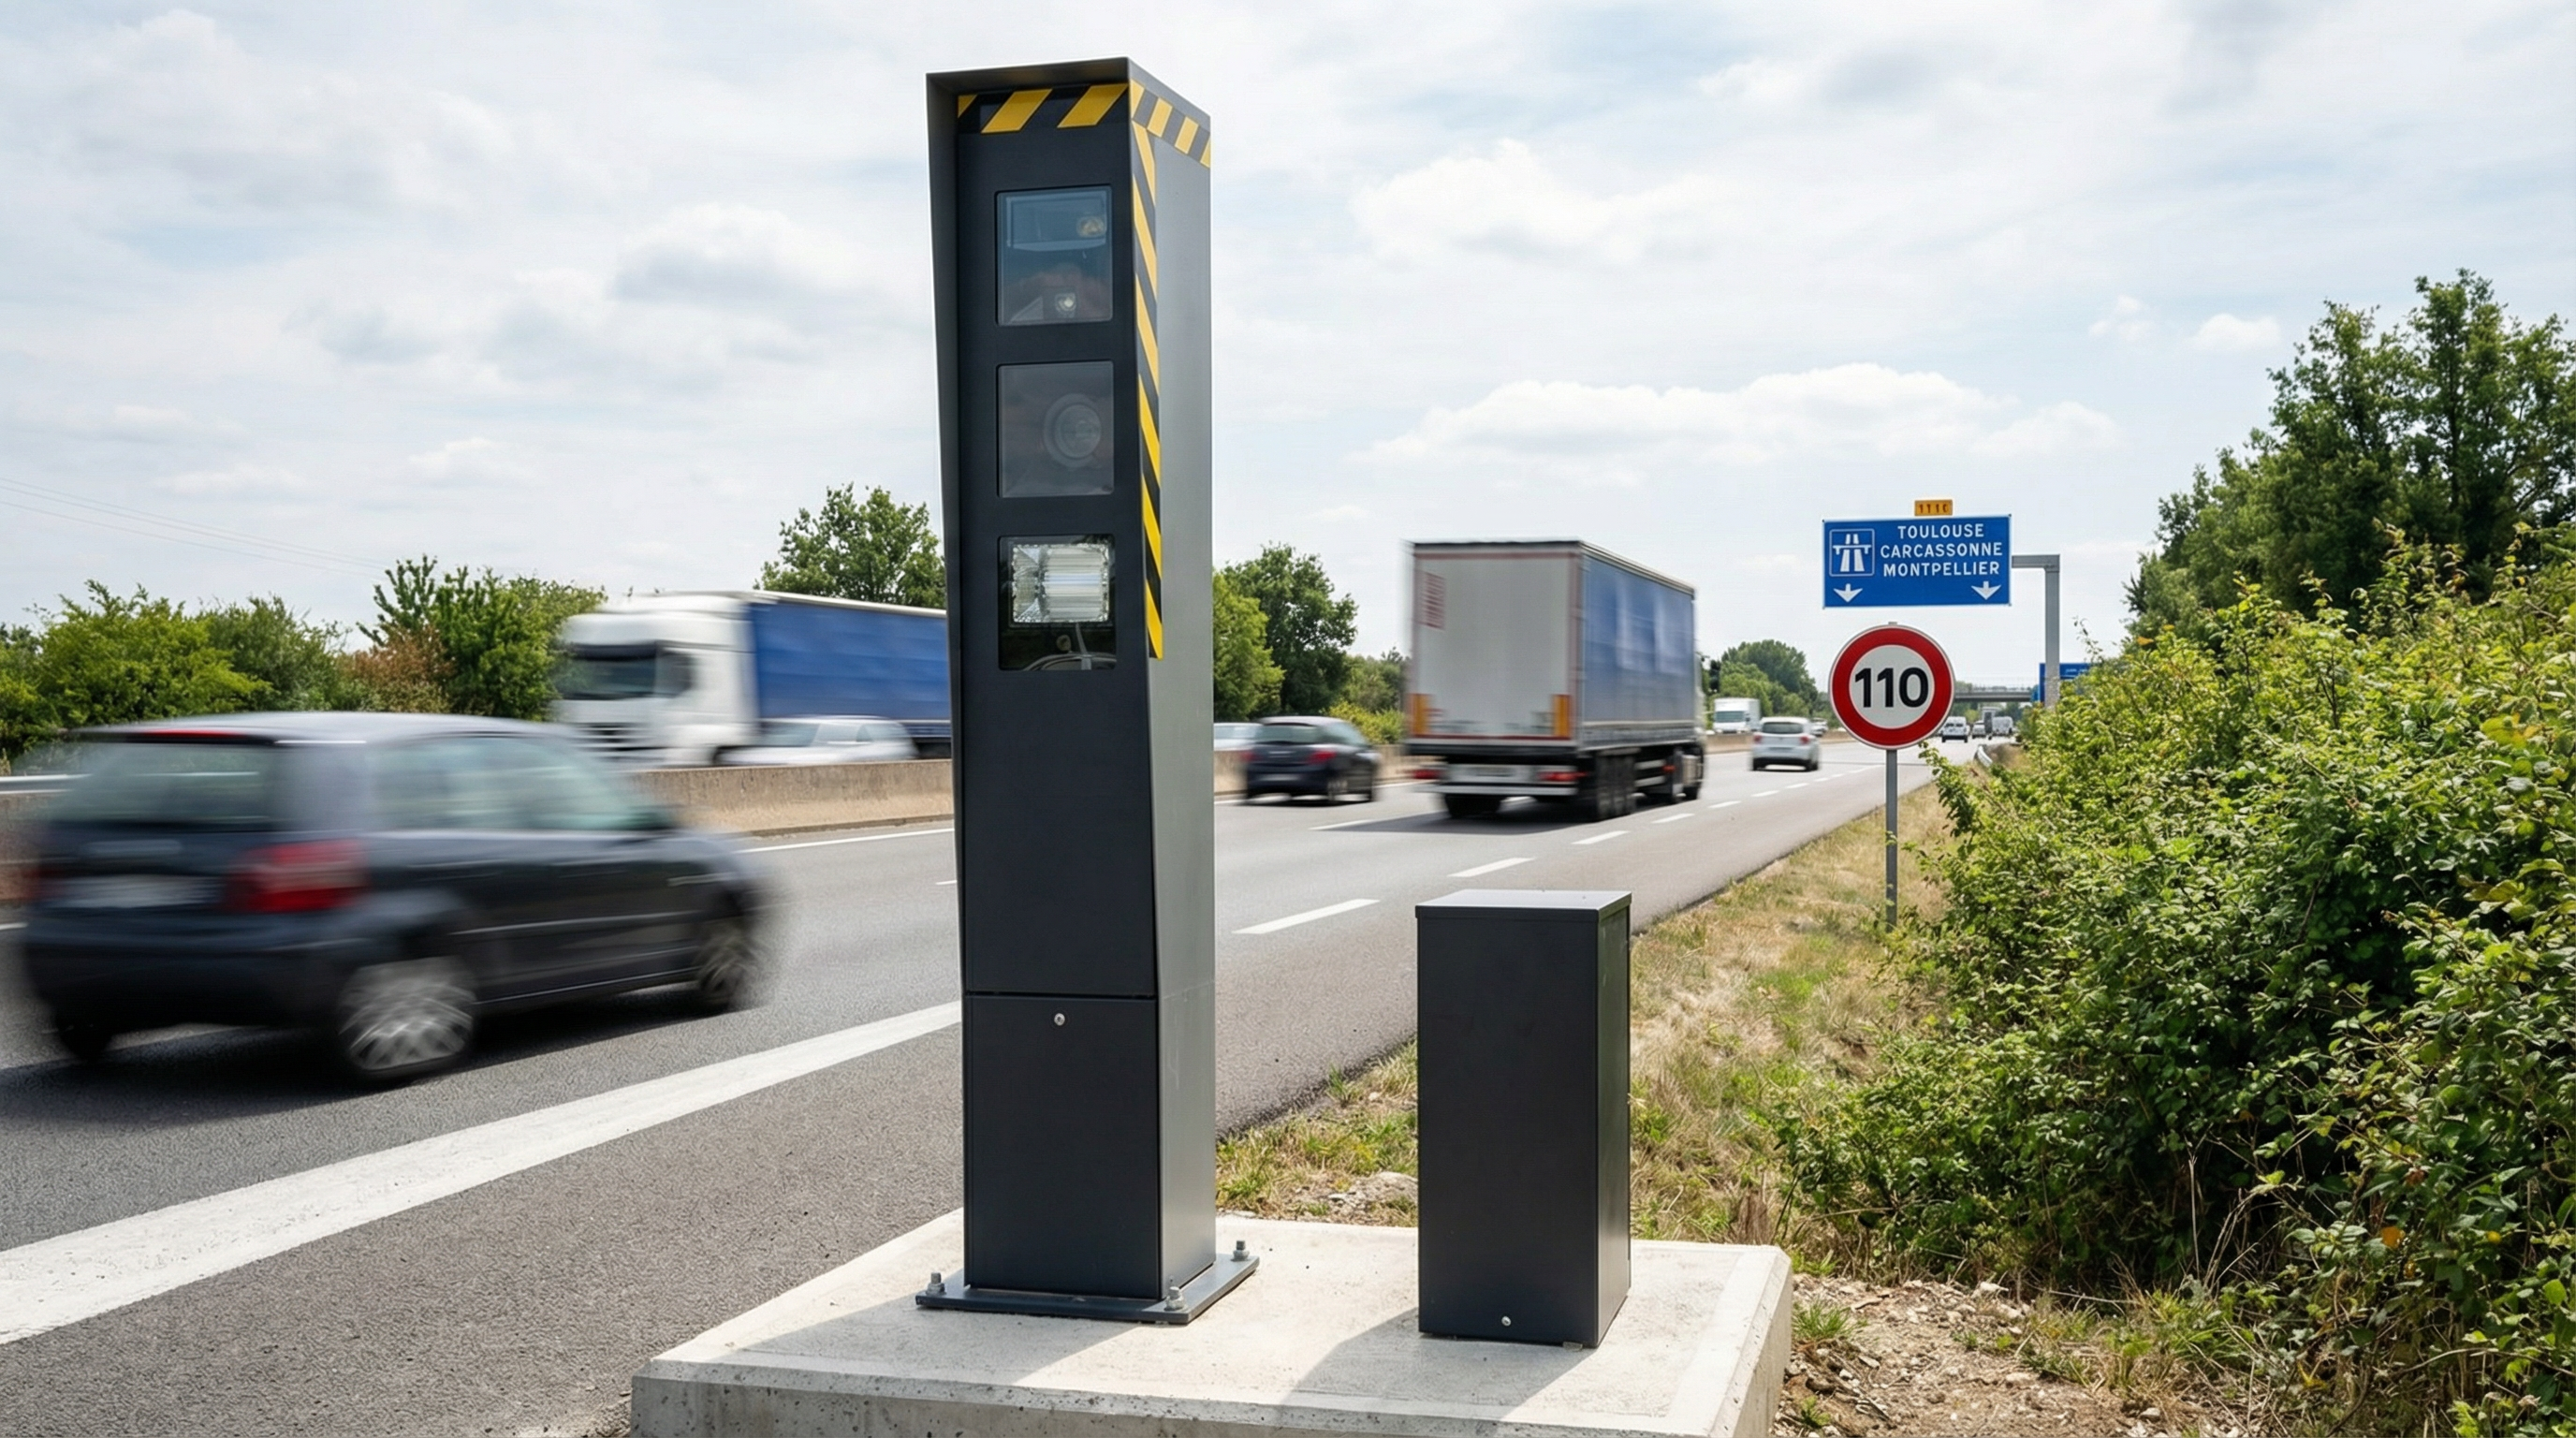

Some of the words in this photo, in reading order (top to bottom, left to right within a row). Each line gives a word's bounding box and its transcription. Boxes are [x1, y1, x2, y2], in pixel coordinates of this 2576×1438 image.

[1897, 523, 1984, 539] TOULOUSE
[1881, 542, 2003, 558] CARCASSONNE
[1883, 562, 1999, 577] MONTPELLIER
[1854, 668, 1929, 709] 110
